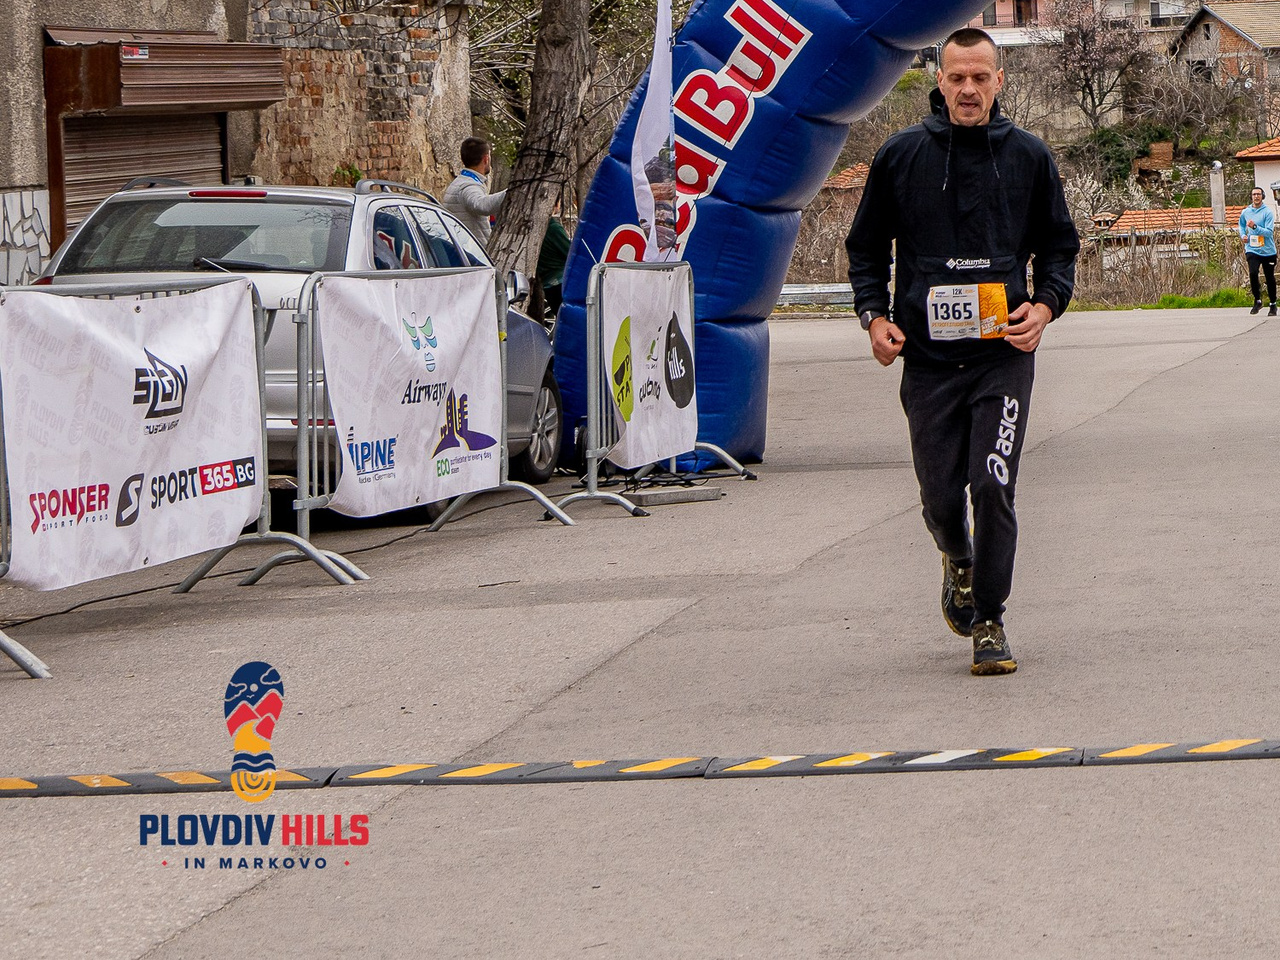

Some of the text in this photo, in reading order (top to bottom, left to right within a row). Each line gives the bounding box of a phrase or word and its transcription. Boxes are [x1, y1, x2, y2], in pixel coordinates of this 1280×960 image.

[931, 302, 973, 321] 1365
[995, 395, 1019, 458] asics
[436, 458, 451, 477] ECO
[29, 483, 110, 535] SPONSER
